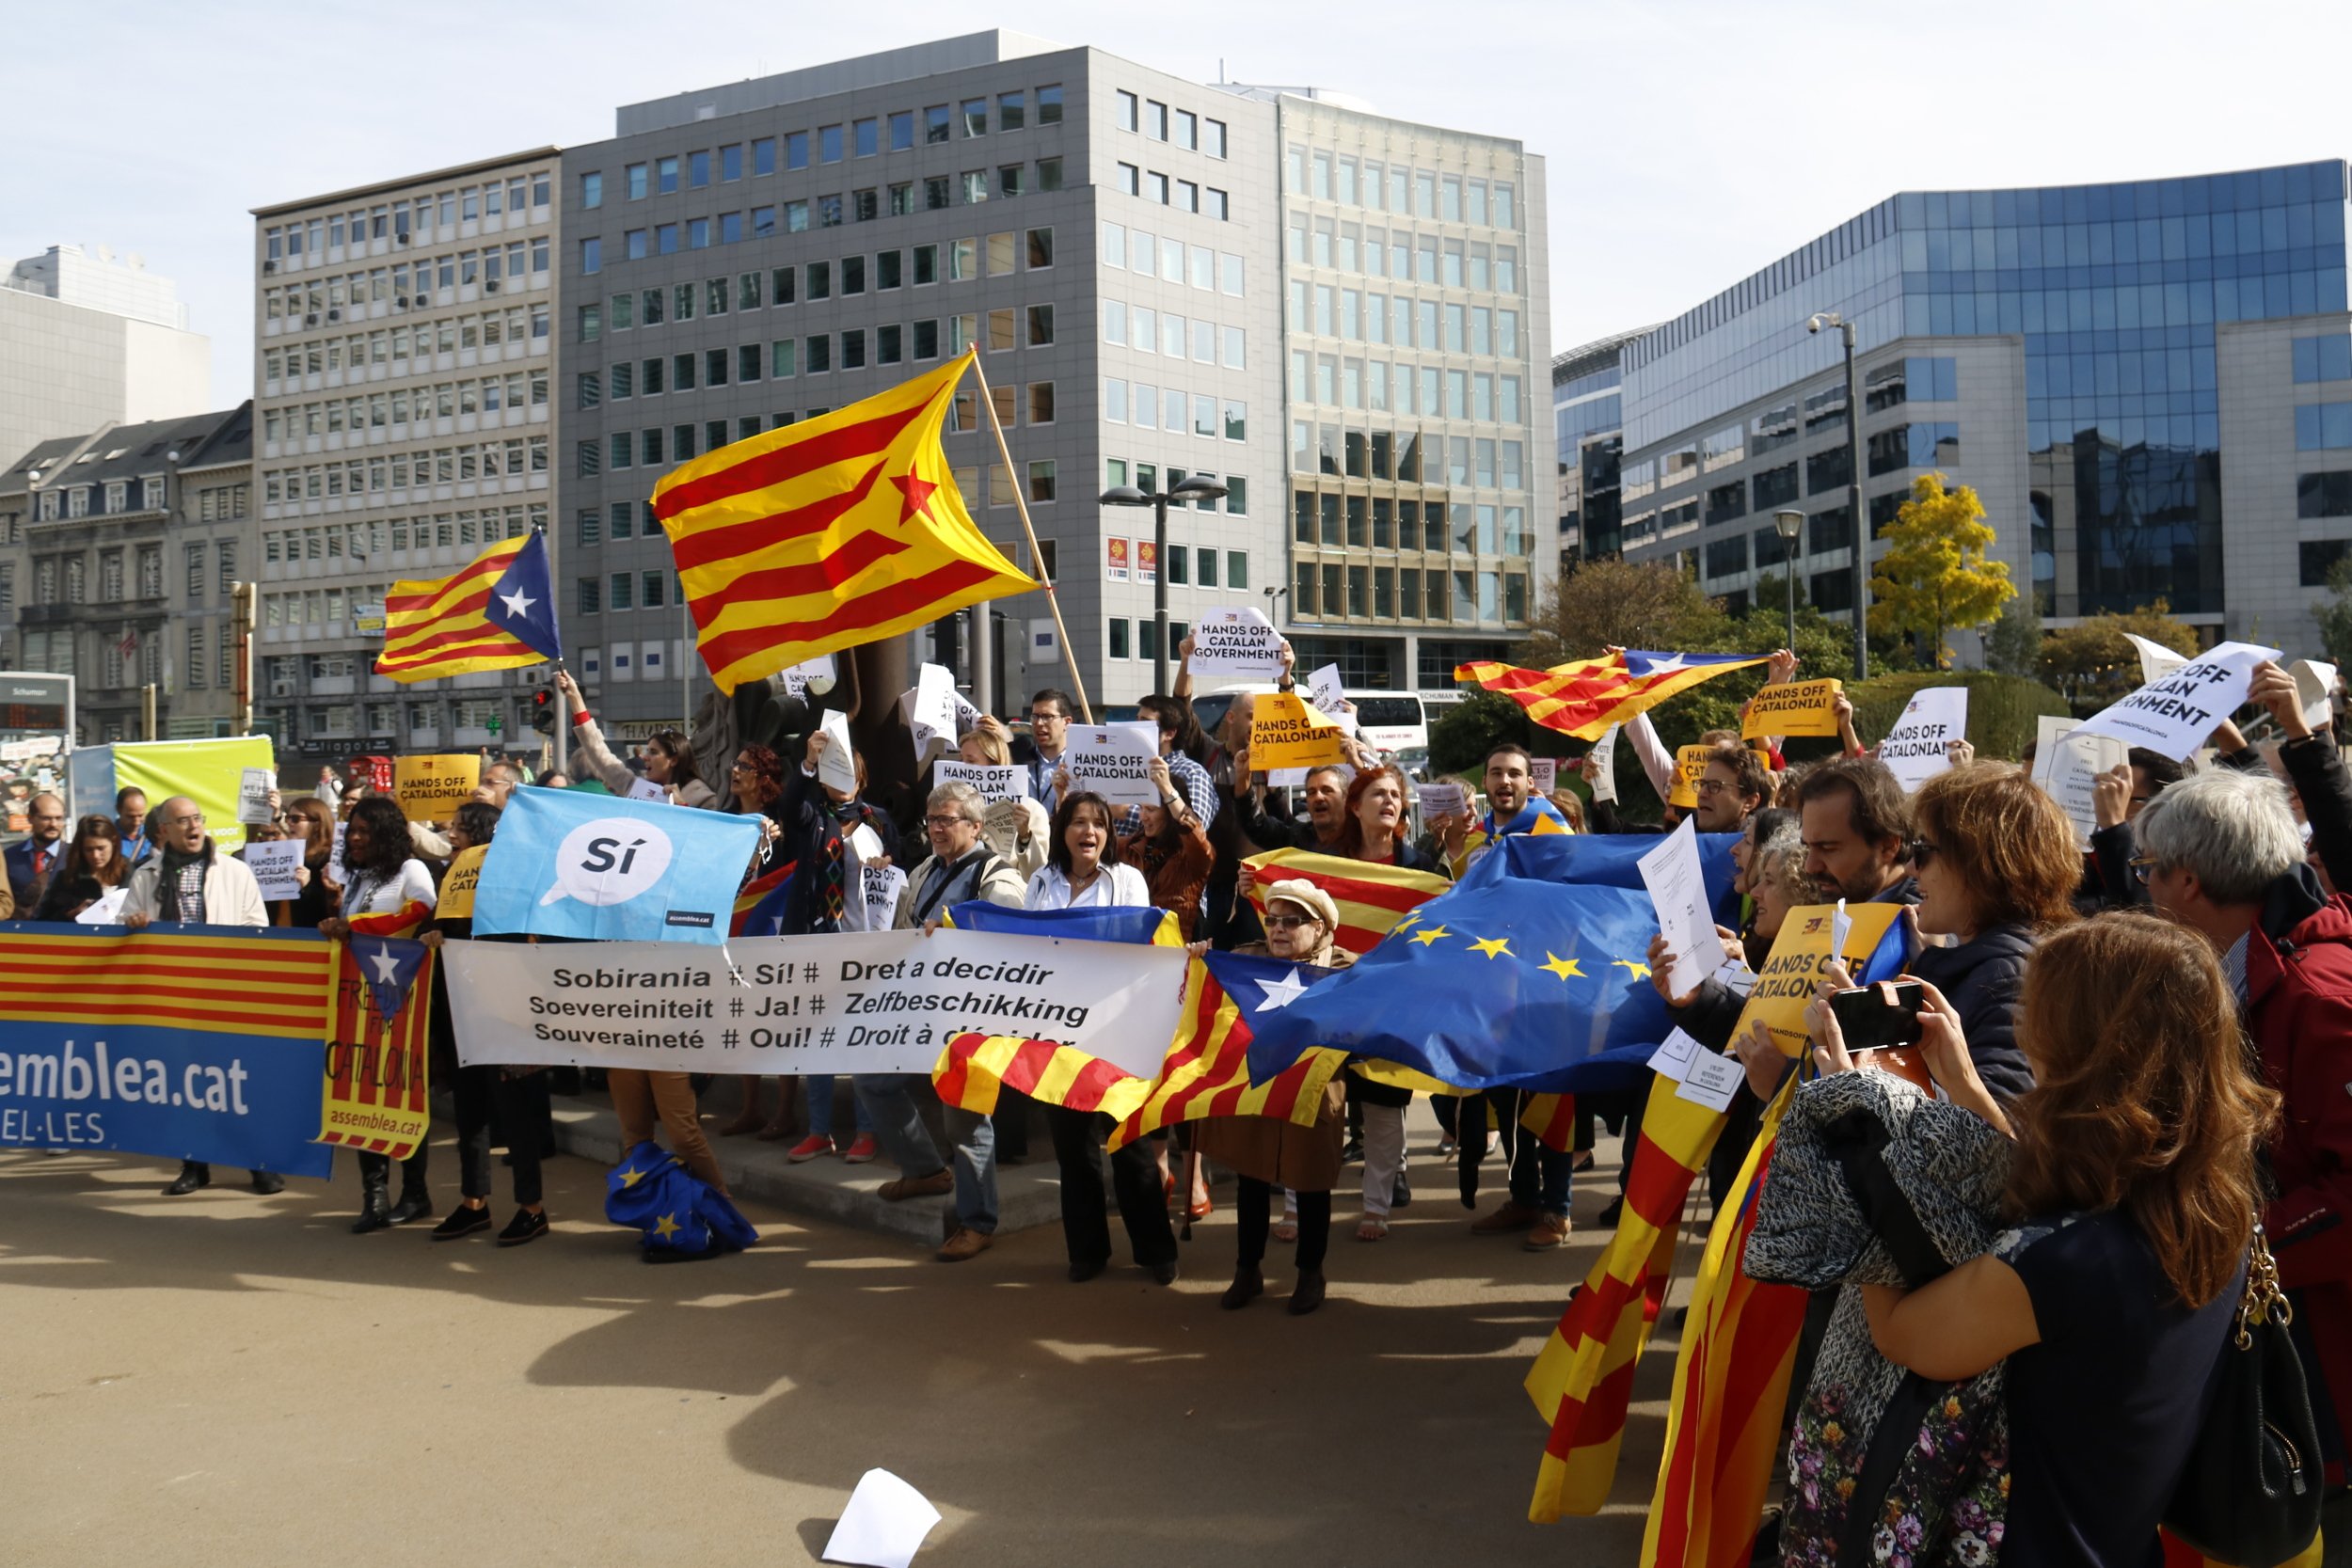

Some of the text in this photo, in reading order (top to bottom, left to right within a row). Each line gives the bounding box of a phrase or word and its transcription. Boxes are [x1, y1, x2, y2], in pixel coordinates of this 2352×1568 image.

[1202, 625, 1247, 635] HANDS
[1209, 636, 1265, 647] CATALAN
[1193, 647, 1280, 660] GOVERNMENT
[2184, 664, 2231, 684] OFF
[1757, 686, 1826, 702] HANDS OFF
[1753, 699, 1827, 714] CATALONIA!
[1256, 720, 1297, 732] HANDS
[1921, 724, 1947, 739] OFF
[1254, 729, 1331, 744] CATALONIA!
[1882, 741, 1947, 758] CATALONIA!
[1074, 752, 1144, 767] HANDS OFF
[944, 766, 1013, 781] HANDS OFF
[1073, 767, 1149, 779] CATALONIA!
[403, 777, 466, 788] HANDS OFF
[400, 788, 468, 800] CATALONIA!
[250, 855, 294, 866] HANDS OFF
[580, 837, 647, 875] Sí
[255, 866, 289, 876] CATALAN
[669, 915, 710, 924] assemblea.cat
[553, 966, 711, 989] Sobirania
[755, 963, 795, 985] Sí!
[803, 962, 819, 983] #
[840, 958, 906, 981] Dret
[911, 961, 925, 977] a
[933, 957, 1054, 985] decidir
[337, 978, 415, 1014] FREEDOM
[529, 990, 1089, 1028] Soevereiniteit # Ja! # Zelfbeschikking
[533, 1022, 706, 1049] Souveraineté
[722, 1029, 740, 1049] #
[750, 1027, 812, 1048] Oui!
[820, 1026, 835, 1048] #
[847, 1023, 911, 1046] Droit
[915, 1022, 934, 1045] à
[330, 1110, 422, 1136] assemblea.cat
